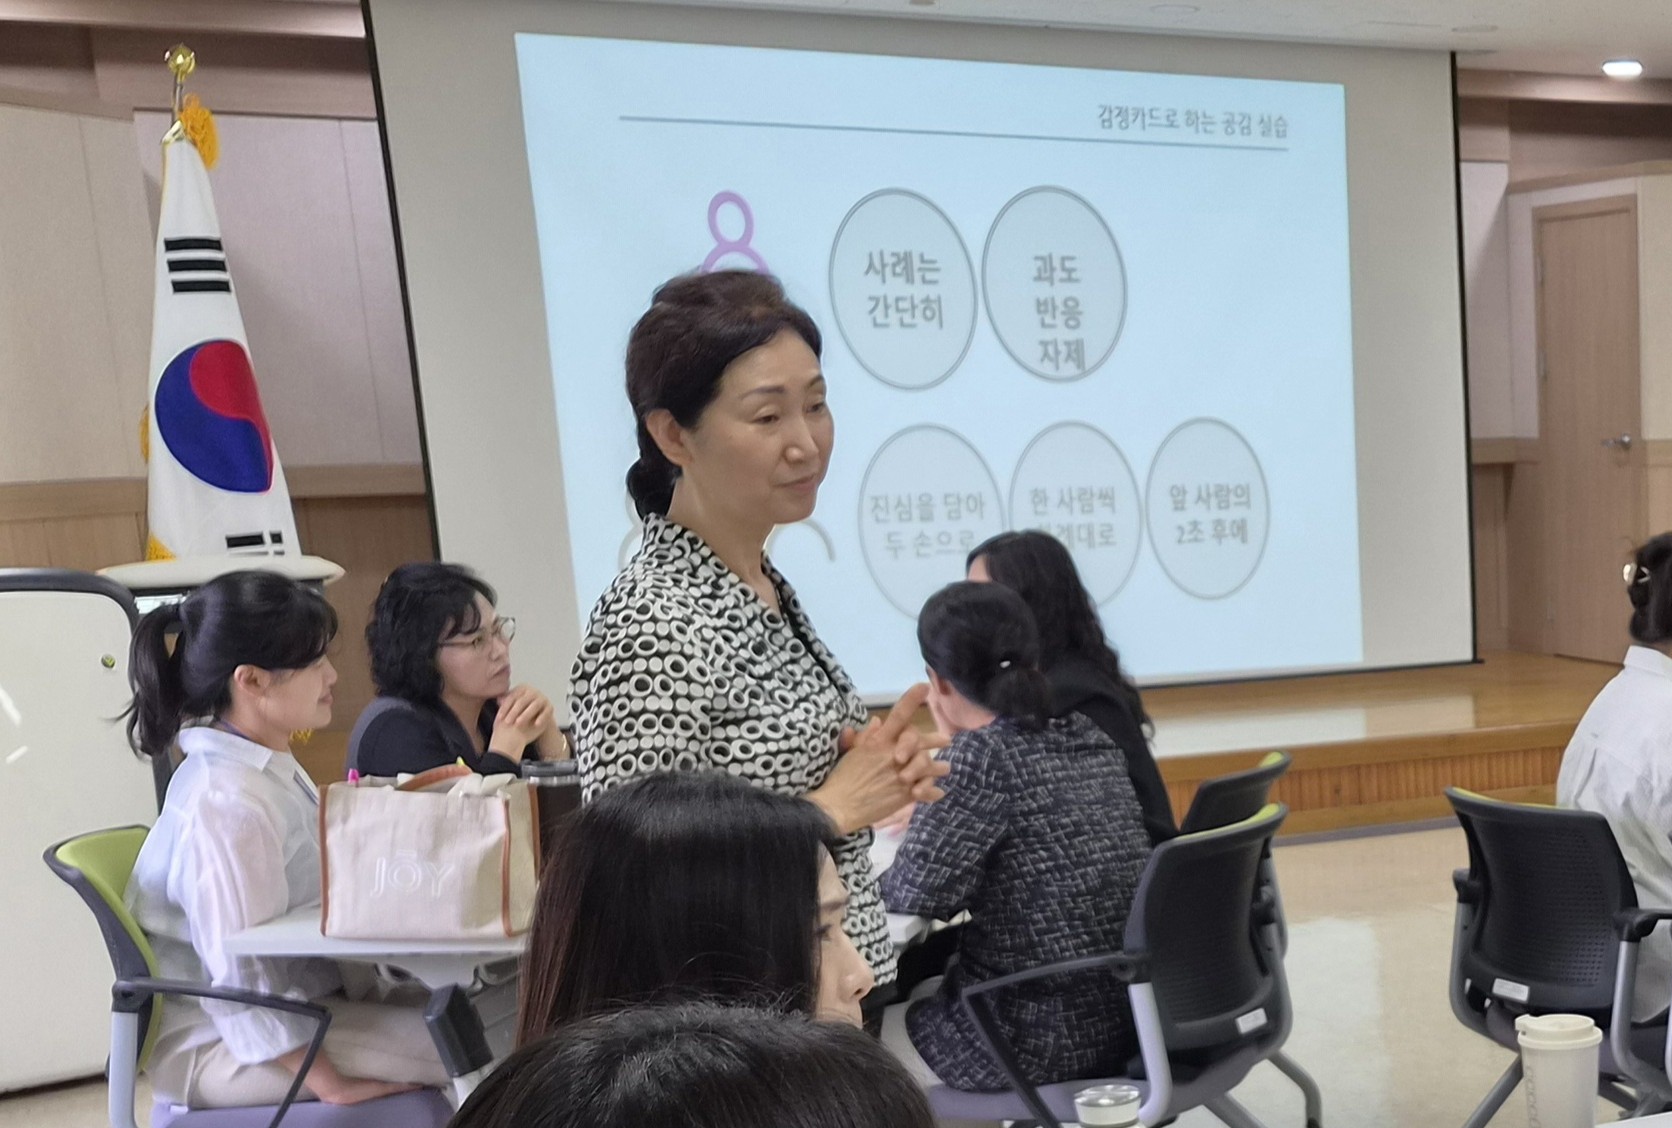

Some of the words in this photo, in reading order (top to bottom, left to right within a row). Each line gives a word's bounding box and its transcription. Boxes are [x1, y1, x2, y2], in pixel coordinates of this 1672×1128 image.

[1098, 104, 1180, 131] 감정카드로
[1184, 109, 1217, 134] 하는
[1221, 111, 1252, 136] 공감
[1258, 114, 1288, 139] 실습
[864, 250, 942, 285] 사례는
[1033, 252, 1081, 287] 과도
[868, 294, 944, 330] 간단히
[1036, 296, 1083, 330] 반응
[1038, 338, 1086, 371] 자제
[870, 493, 936, 524] 진심을
[943, 491, 985, 522] 담아
[1029, 487, 1050, 516] 한
[1057, 485, 1117, 516] 사람씩
[1169, 484, 1188, 511] 앞
[1194, 482, 1253, 512] 사람의
[885, 531, 907, 560] 두
[1176, 520, 1206, 546] 2초
[1211, 518, 1250, 546] 후에
